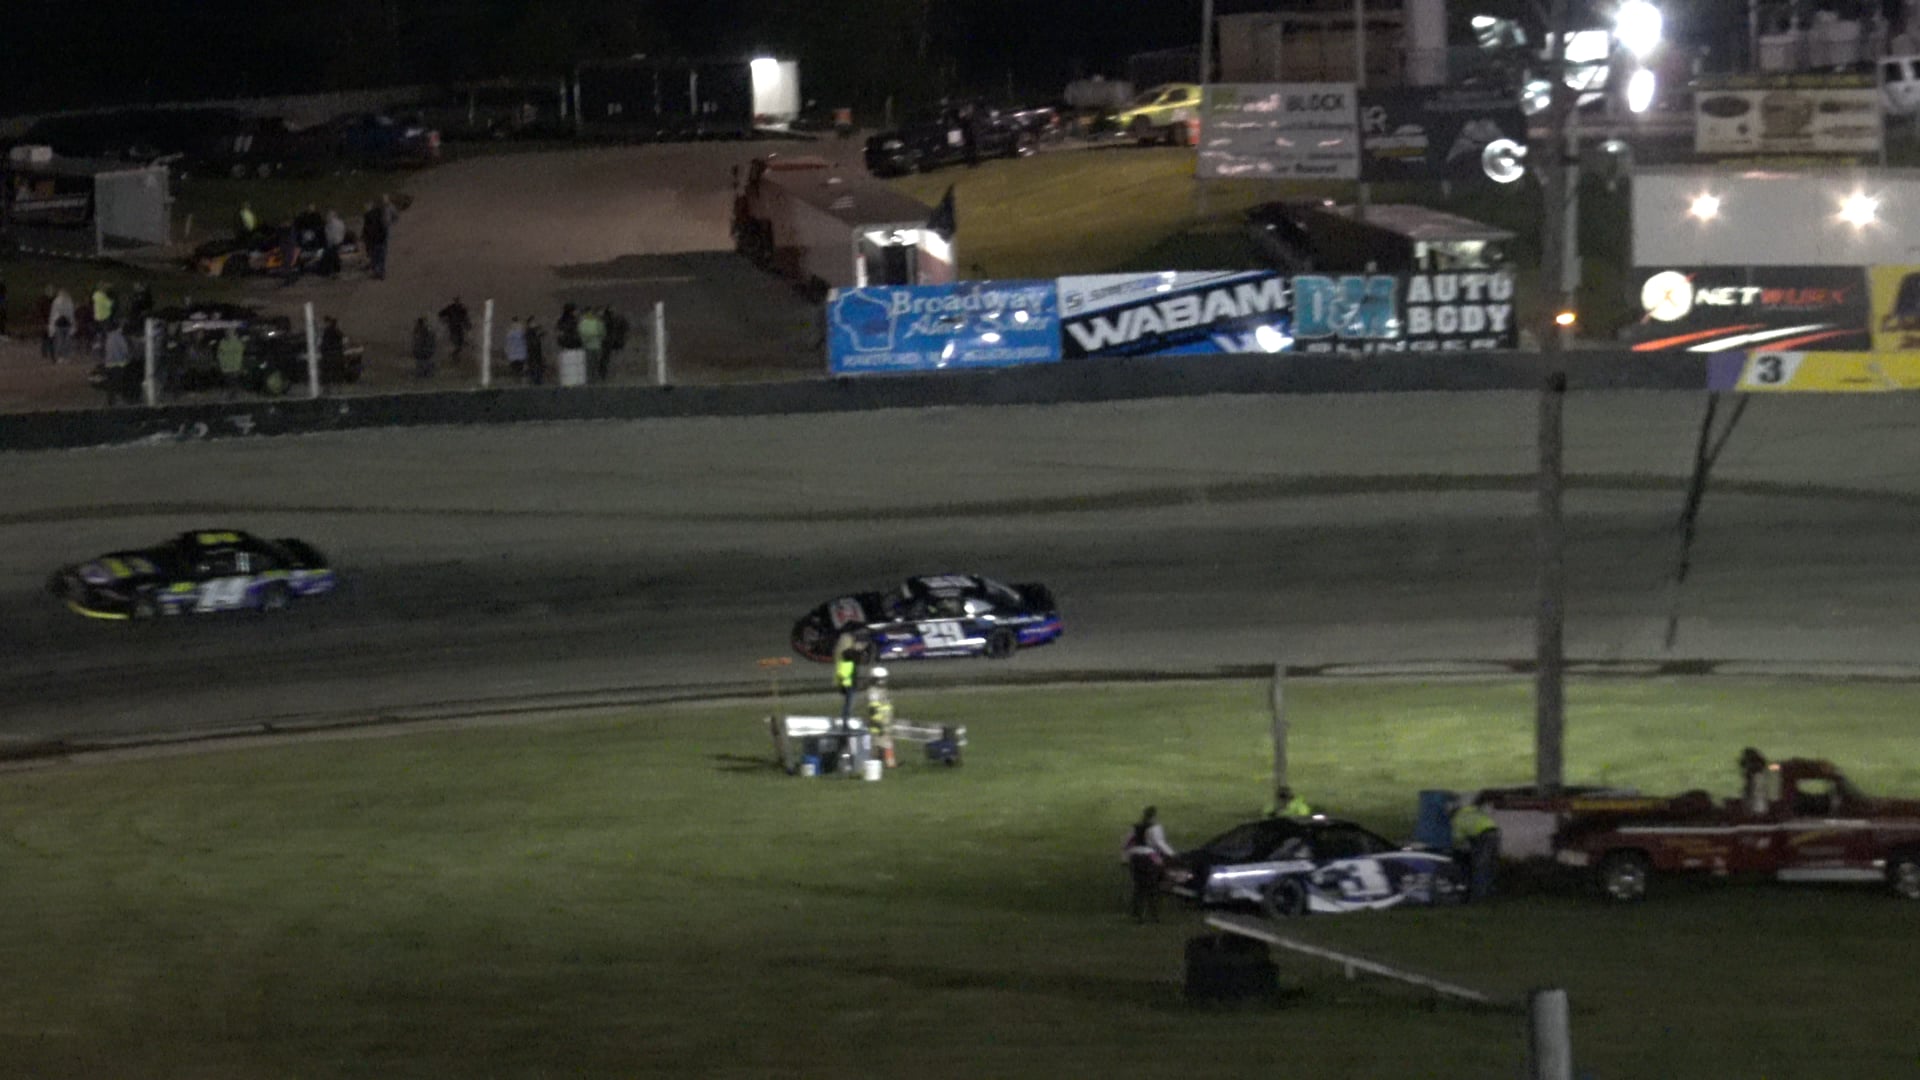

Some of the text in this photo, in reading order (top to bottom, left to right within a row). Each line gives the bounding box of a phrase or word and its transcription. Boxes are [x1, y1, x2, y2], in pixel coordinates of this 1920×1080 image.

[887, 285, 1049, 316] Broadway
[1407, 272, 1513, 302] AUTO
[1065, 277, 1286, 351] WABAM
[1407, 304, 1511, 334] BODY
[1757, 354, 1783, 383] 3
